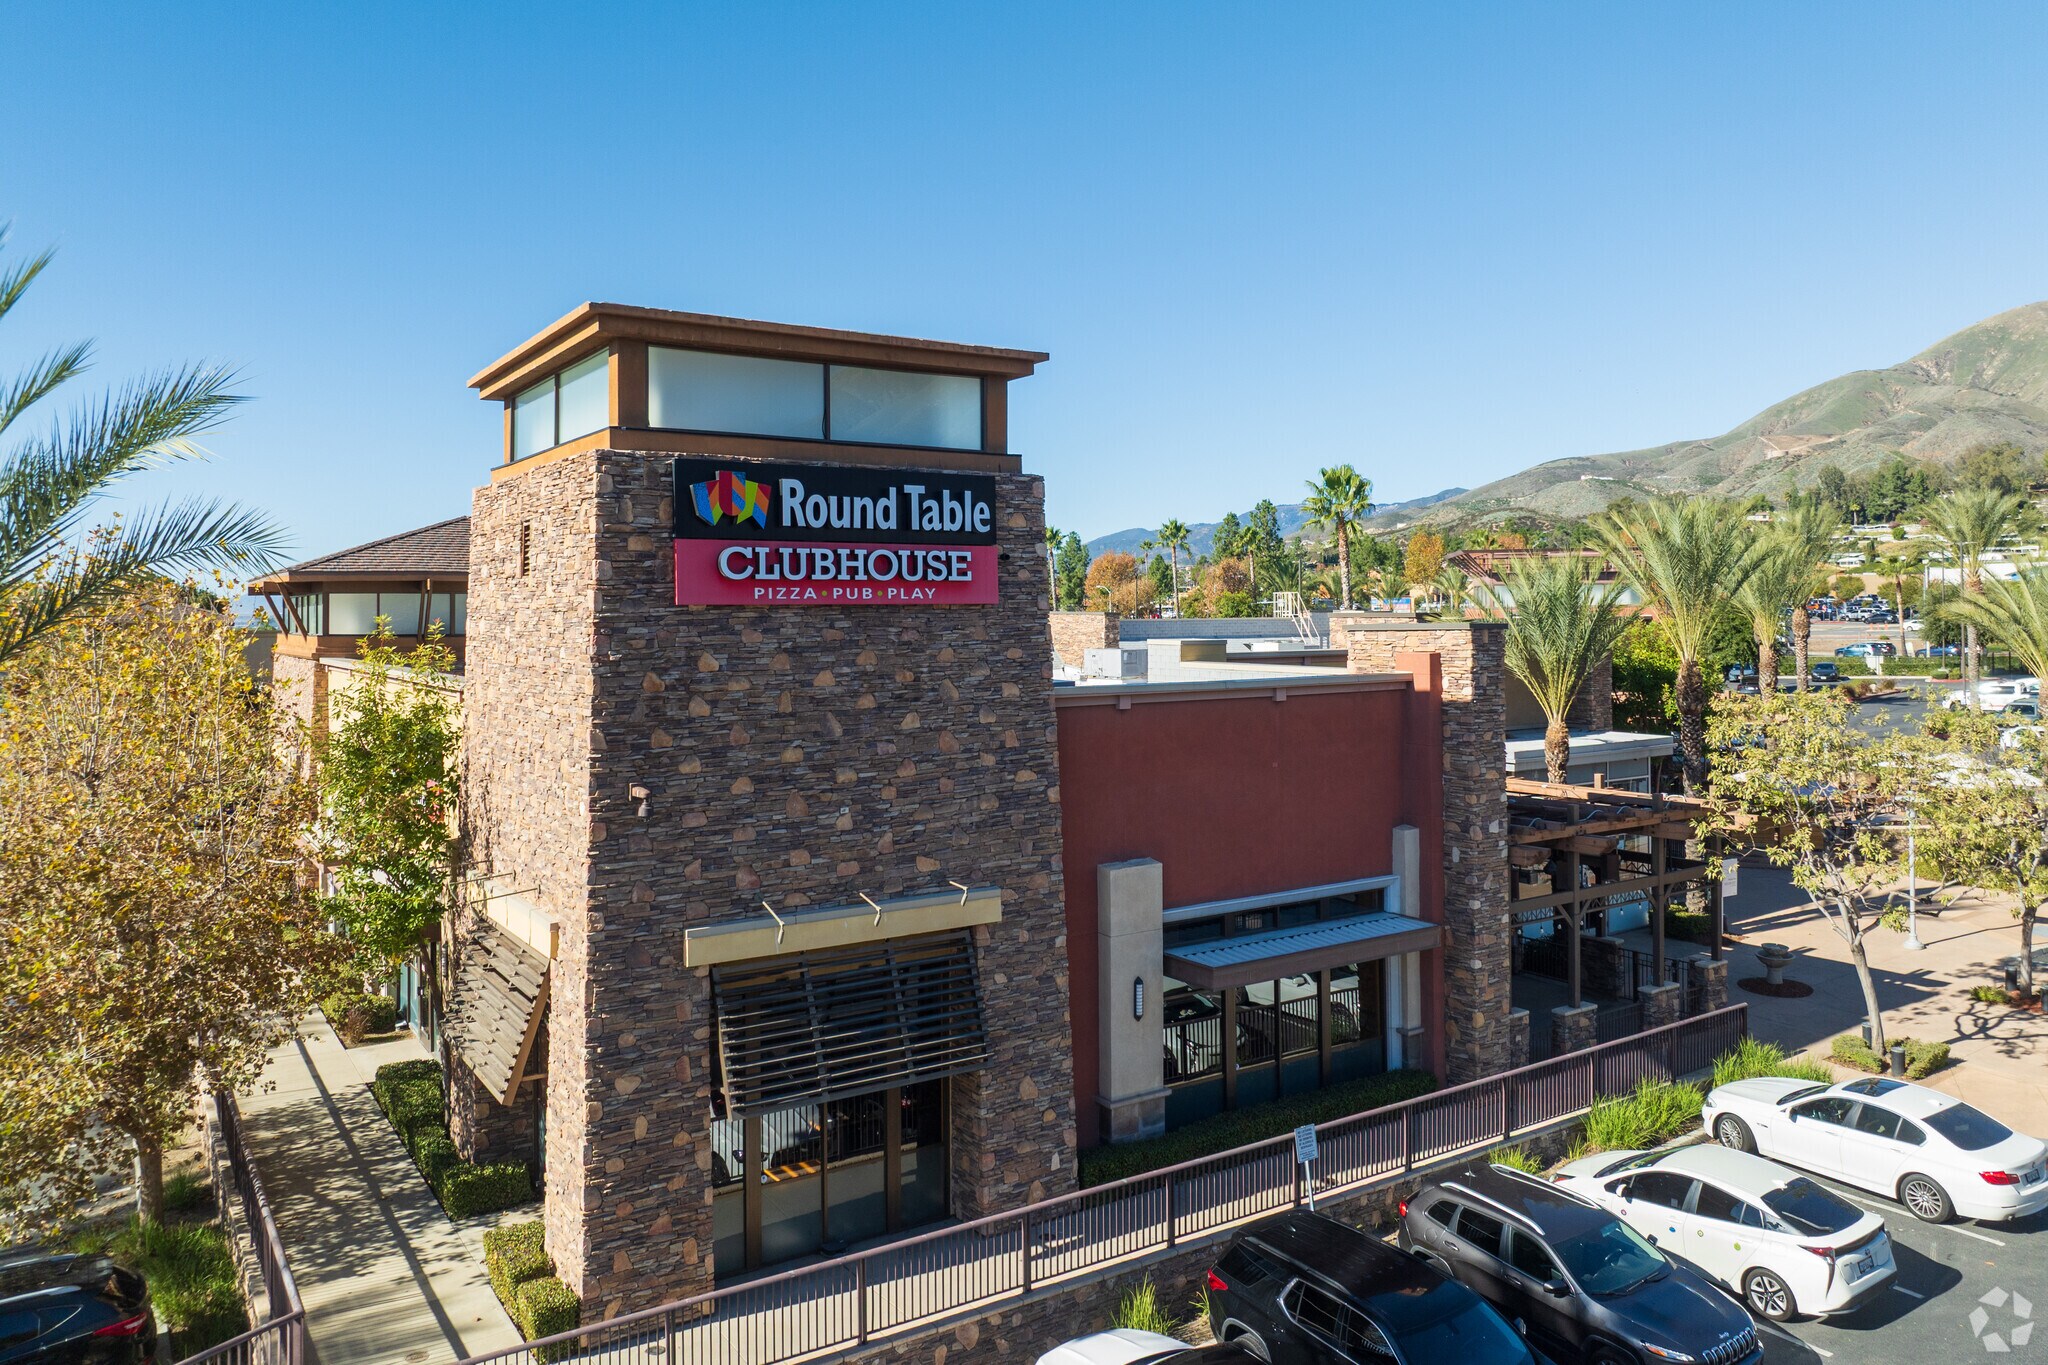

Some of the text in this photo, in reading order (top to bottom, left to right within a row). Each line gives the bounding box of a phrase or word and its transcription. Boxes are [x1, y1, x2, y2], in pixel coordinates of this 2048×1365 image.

[778, 478, 991, 533] Round Table
[717, 546, 972, 582] CLUBHOUSE
[754, 587, 936, 600] PIZZA PUB PLAY
